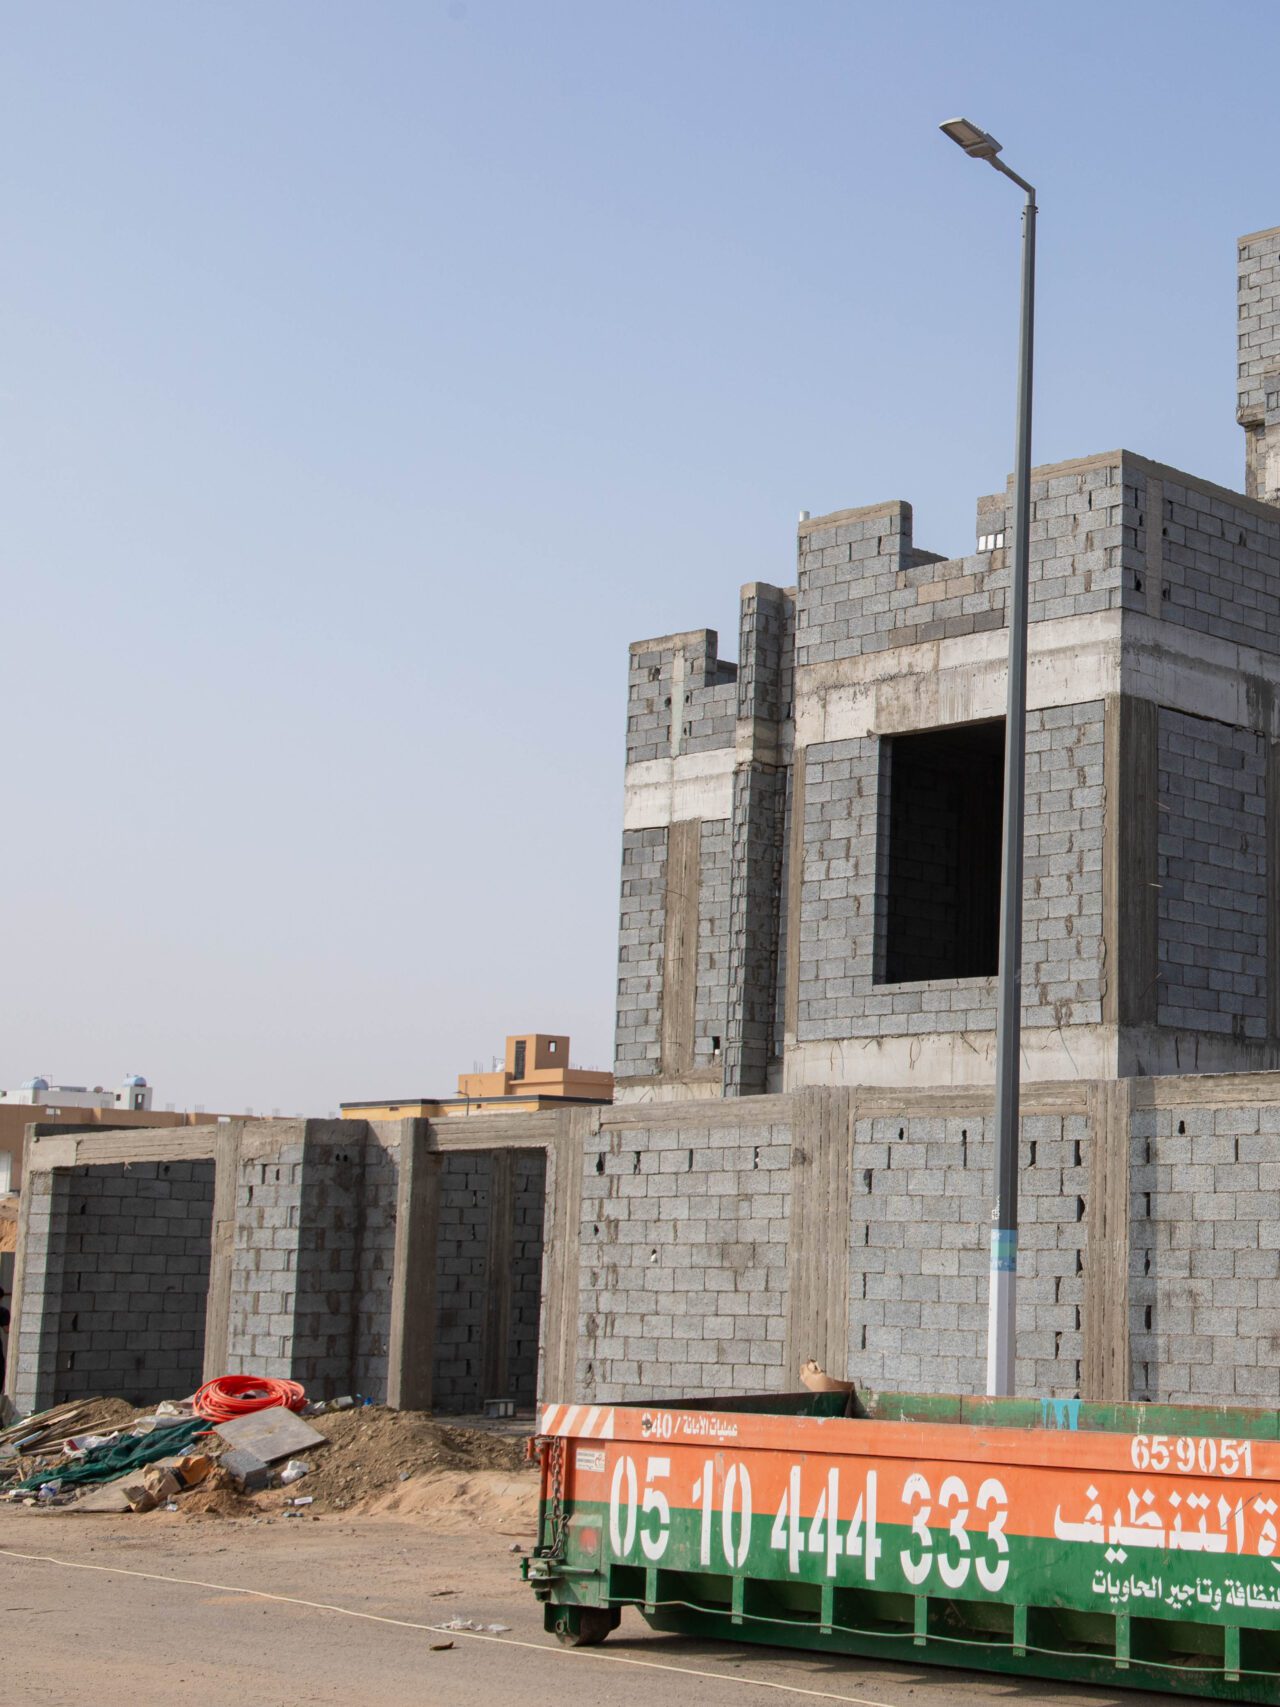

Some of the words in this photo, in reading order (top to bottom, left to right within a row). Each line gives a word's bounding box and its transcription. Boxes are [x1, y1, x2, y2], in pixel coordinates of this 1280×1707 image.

[710, 1416, 738, 1441] عمليات
[609, 1455, 671, 1561] 05
[692, 1460, 752, 1569] 10
[770, 1465, 882, 1582] 444
[900, 1472, 1010, 1593] 333
[1053, 1484, 1246, 1564] التنظيف
[1091, 1569, 1162, 1603] الحاويات
[1165, 1576, 1222, 1611] وتأجير
